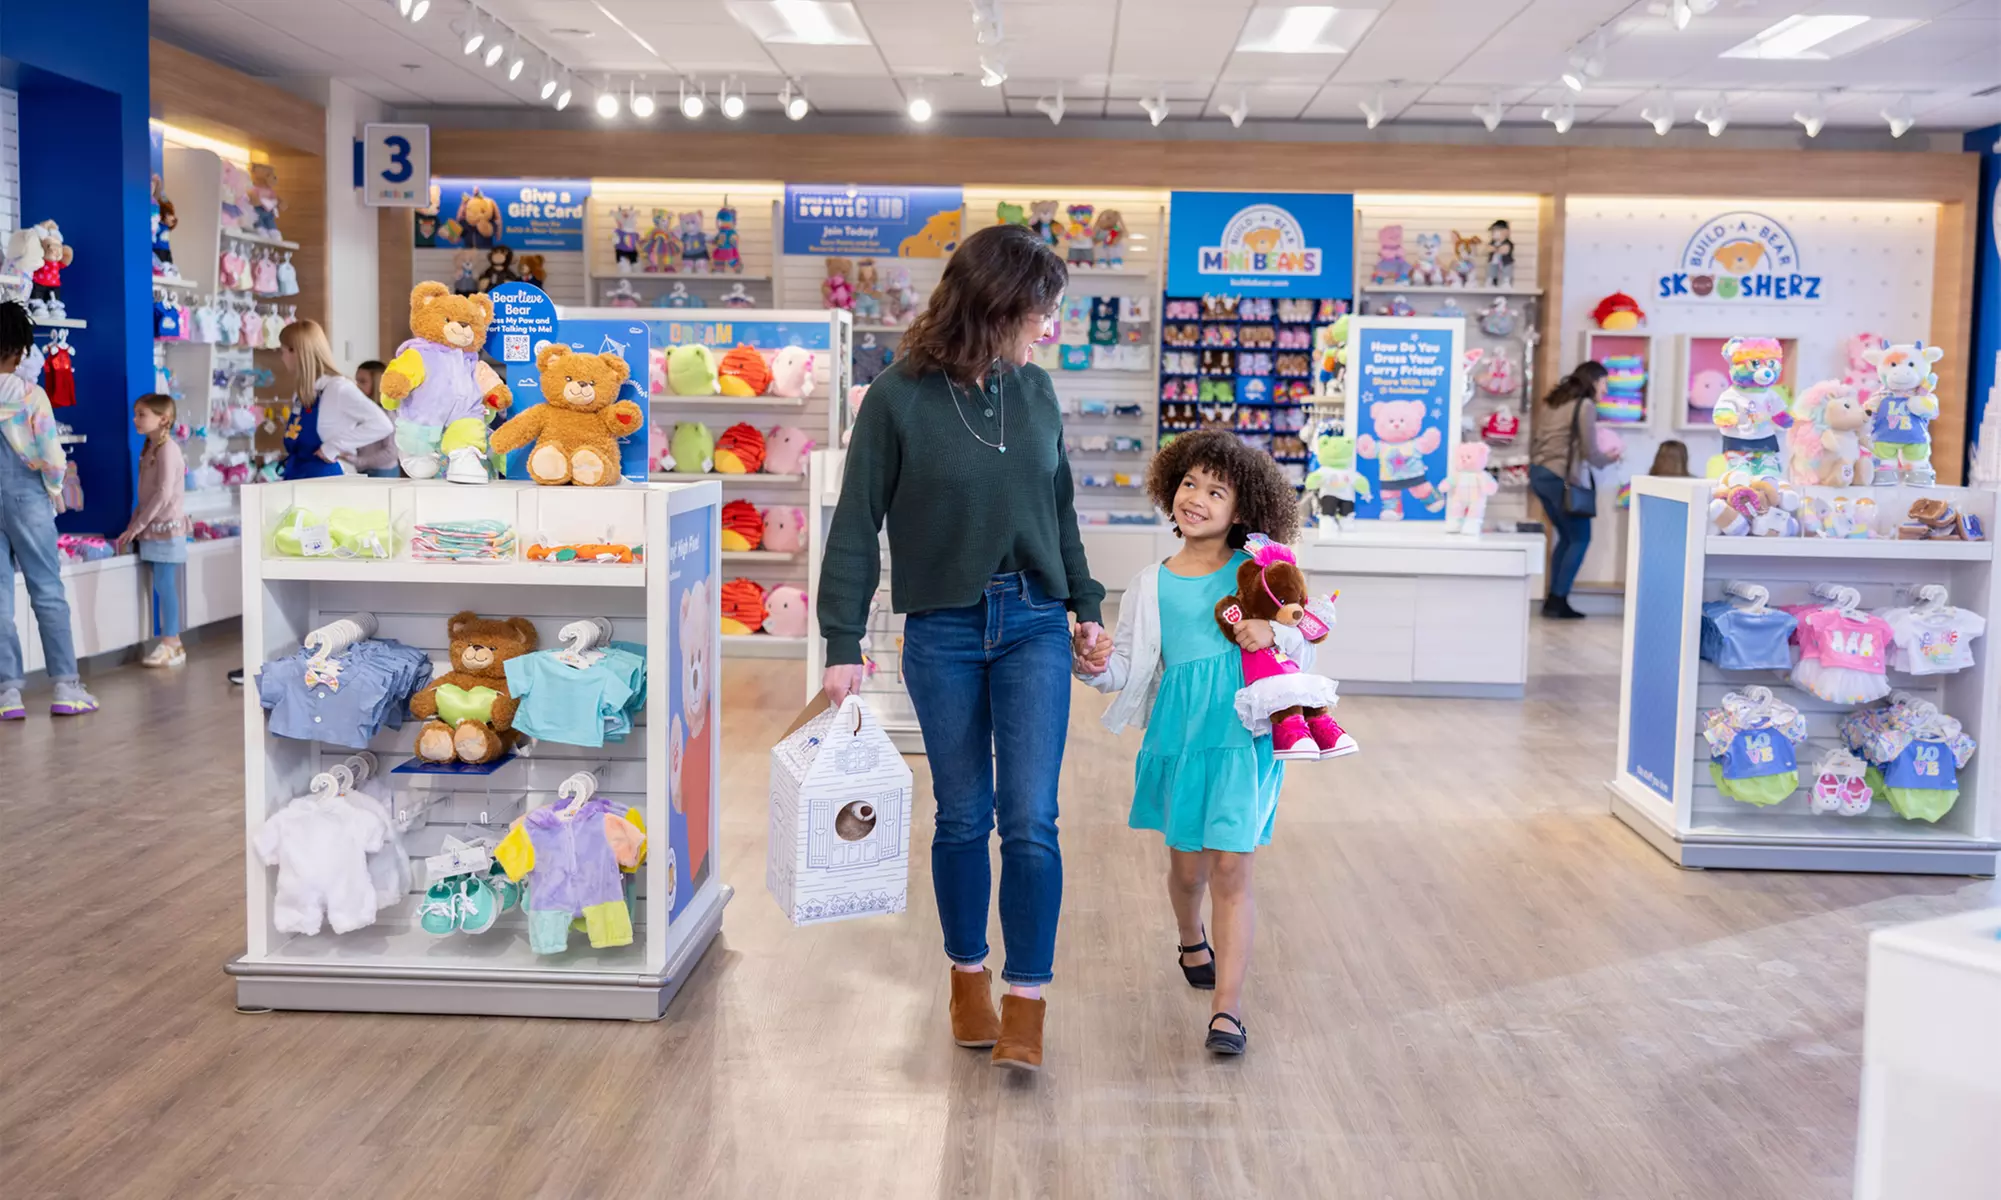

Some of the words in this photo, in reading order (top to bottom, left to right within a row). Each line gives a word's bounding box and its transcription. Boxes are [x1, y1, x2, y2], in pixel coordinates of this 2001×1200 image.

[381, 135, 413, 183] 3
[520, 187, 557, 203] Give
[560, 191, 571, 203] a
[508, 203, 540, 218] Gift
[544, 203, 583, 219] Card
[823, 226, 843, 239] Join
[845, 226, 878, 239] Today!
[1690, 225, 1725, 267] BUILD
[1737, 221, 1747, 232] A
[1759, 225, 1791, 266] BEAR
[1254, 252, 1316, 272] BEANS
[493, 290, 543, 303] Bearlieve
[505, 304, 531, 315] Bear
[505, 317, 517, 325] My
[501, 325, 527, 334] Talking
[538, 325, 552, 333] Me!
[669, 323, 733, 345] DREAM
[1371, 341, 1398, 352] How
[1400, 342, 1416, 352] Do
[1418, 342, 1440, 353] You
[1374, 353, 1407, 364] Dress
[1408, 354, 1437, 364] Your
[1365, 365, 1398, 377] Furry
[1400, 365, 1444, 376] Friend?
[1915, 745, 1939, 761] LO
[1913, 760, 1940, 776] VE
